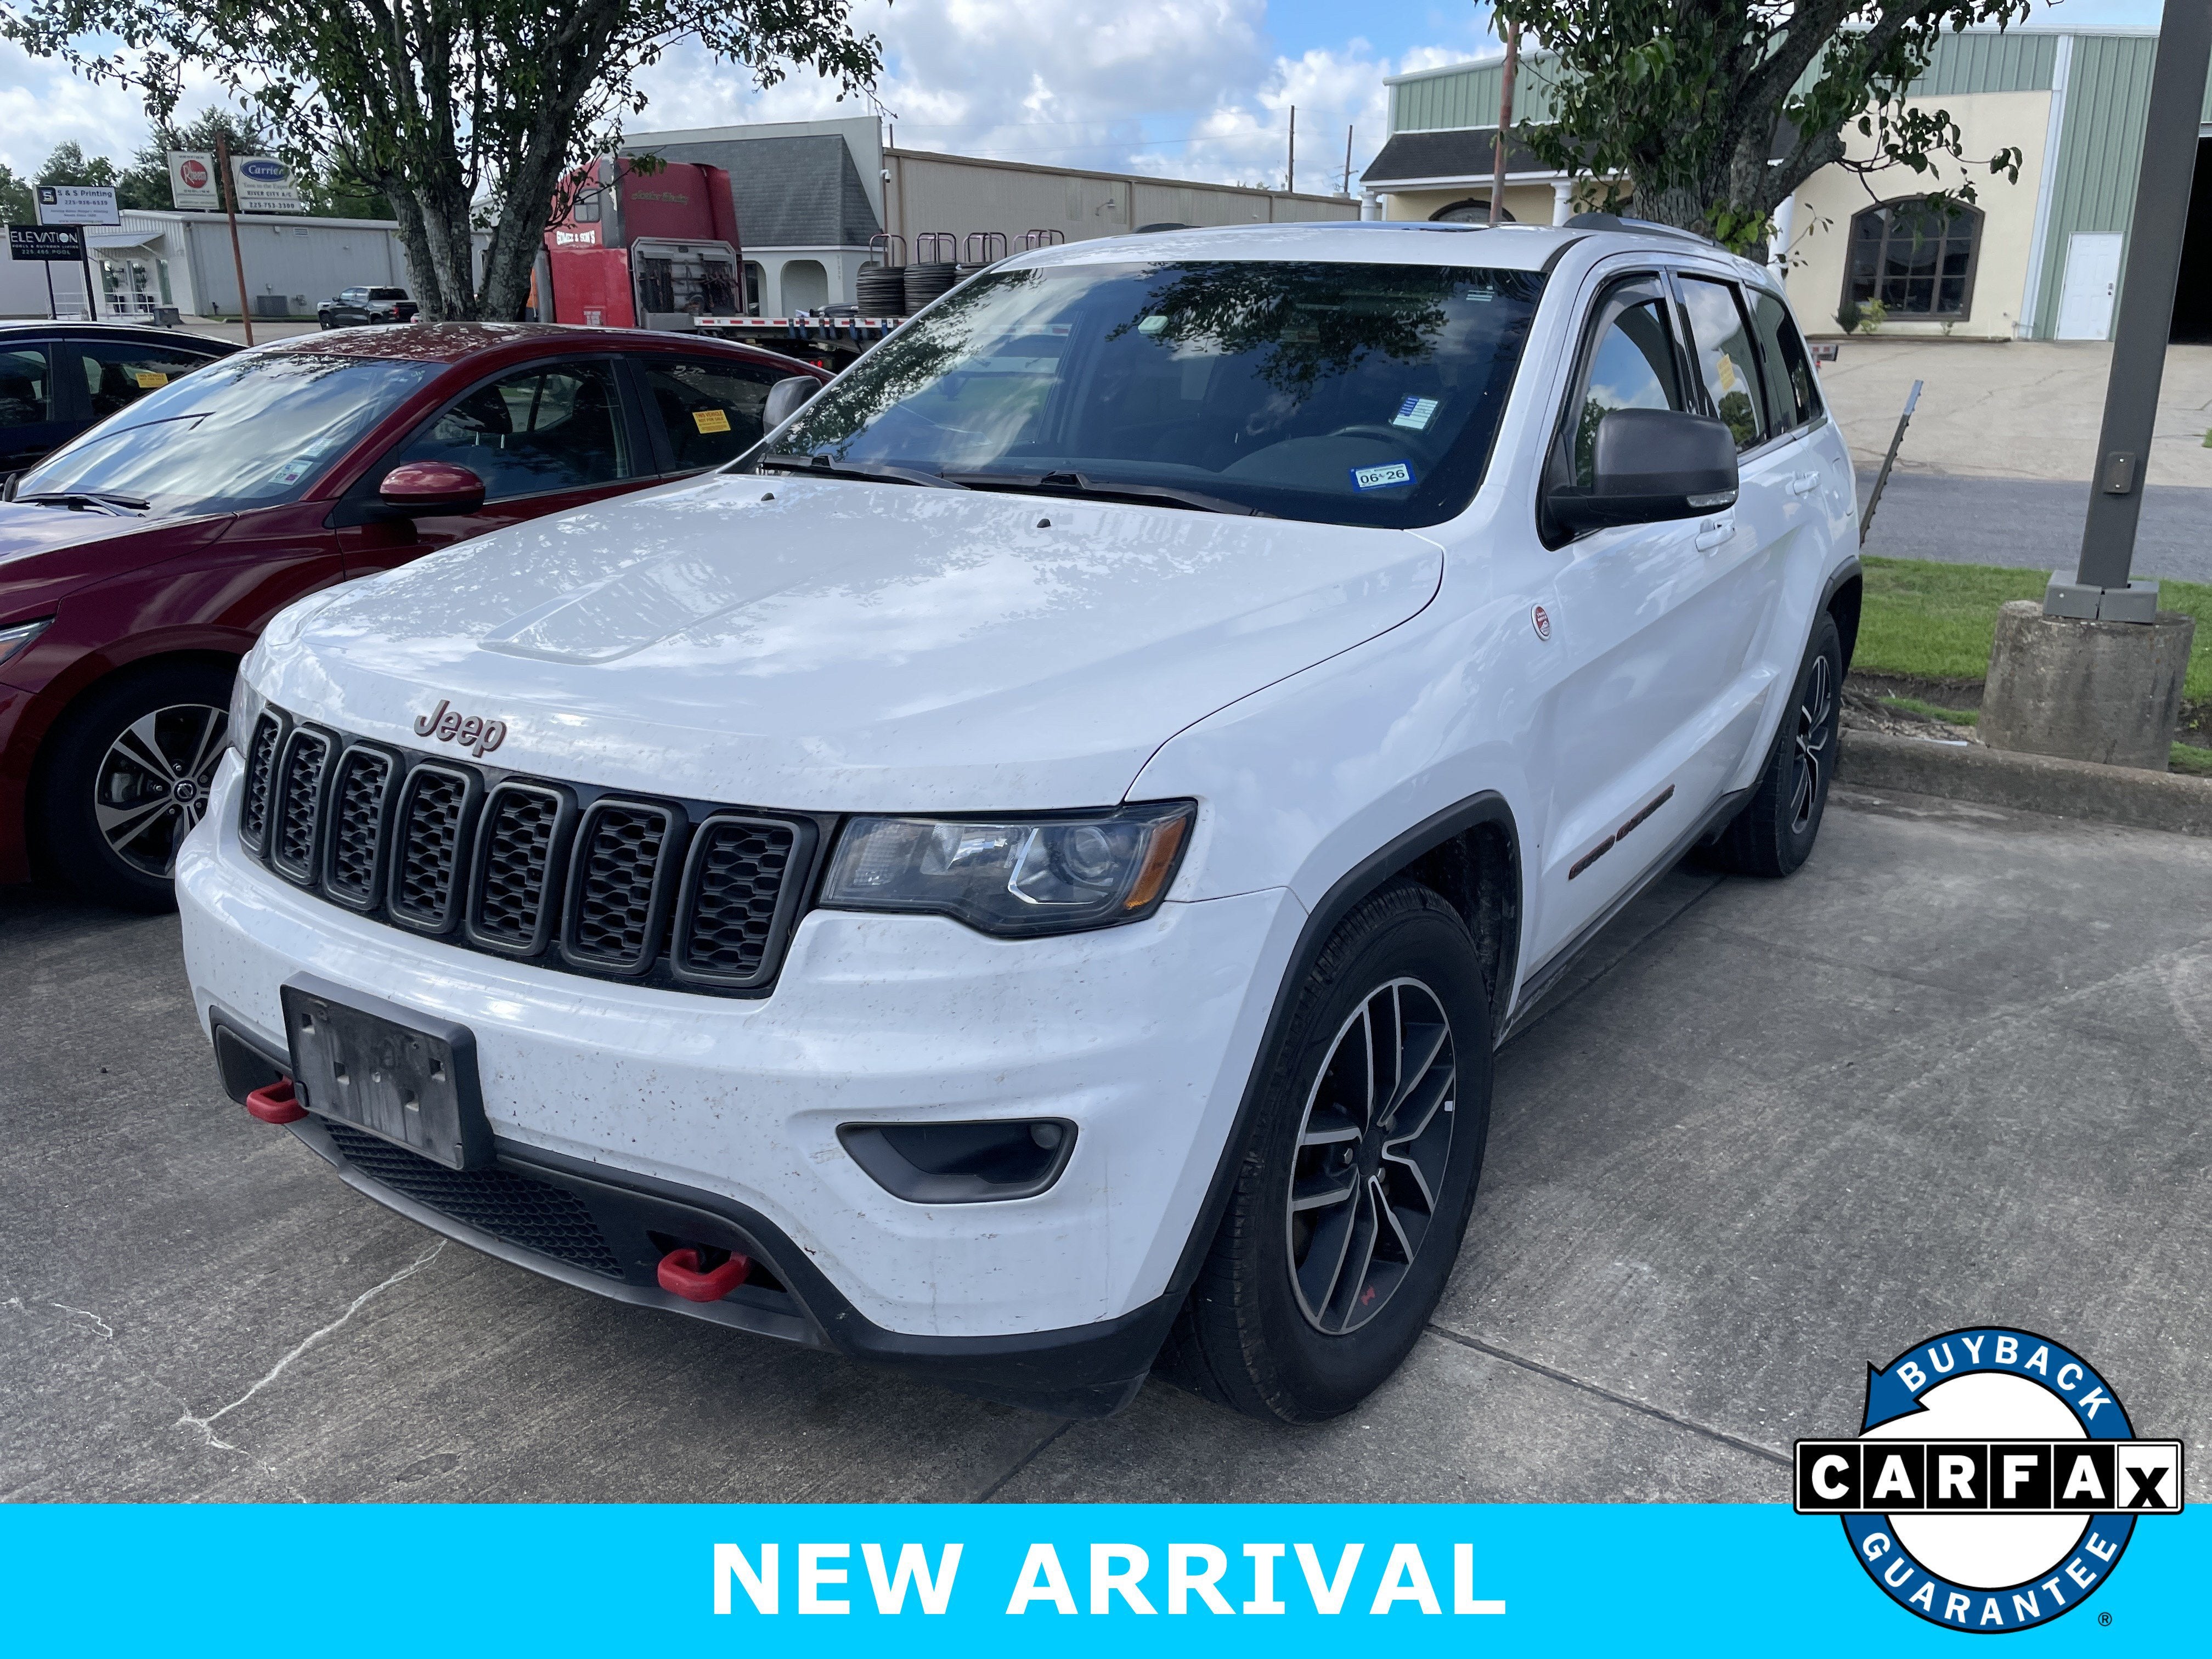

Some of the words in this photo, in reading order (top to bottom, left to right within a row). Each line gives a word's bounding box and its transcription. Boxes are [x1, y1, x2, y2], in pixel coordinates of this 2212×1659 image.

[81, 190, 112, 198] Printing
[10, 231, 78, 243] ELEVATION
[1361, 473, 1379, 484] 06
[1386, 470, 1405, 480] 26
[414, 699, 507, 758] Jeep
